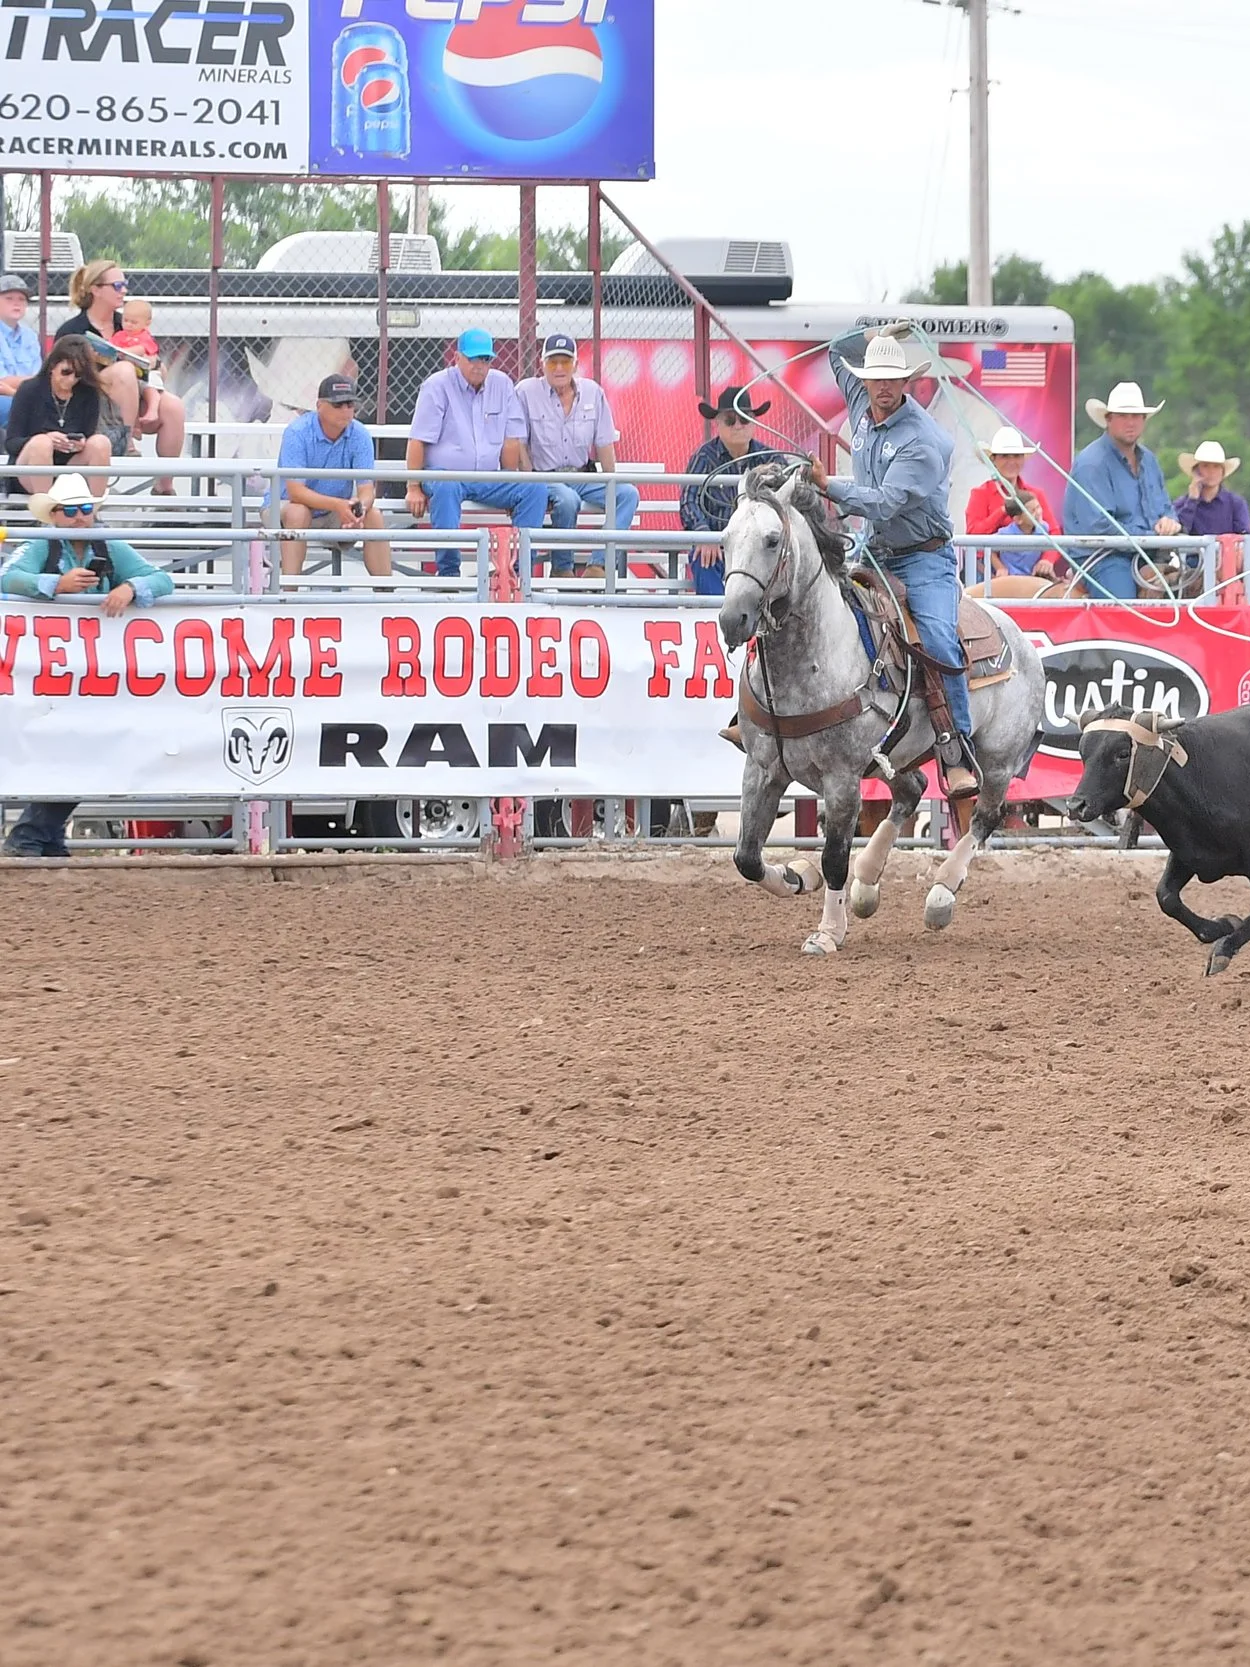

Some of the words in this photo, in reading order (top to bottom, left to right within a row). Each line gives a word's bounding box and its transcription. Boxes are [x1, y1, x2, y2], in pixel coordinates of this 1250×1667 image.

[0, 0, 295, 66] TRACER
[198, 68, 292, 84] MINERALS
[0, 93, 280, 126] 620-865-2041
[380, 616, 610, 698] RODEO
[643, 620, 757, 698] FA
[1044, 659, 1182, 728] ustin
[318, 722, 578, 768] RAM
